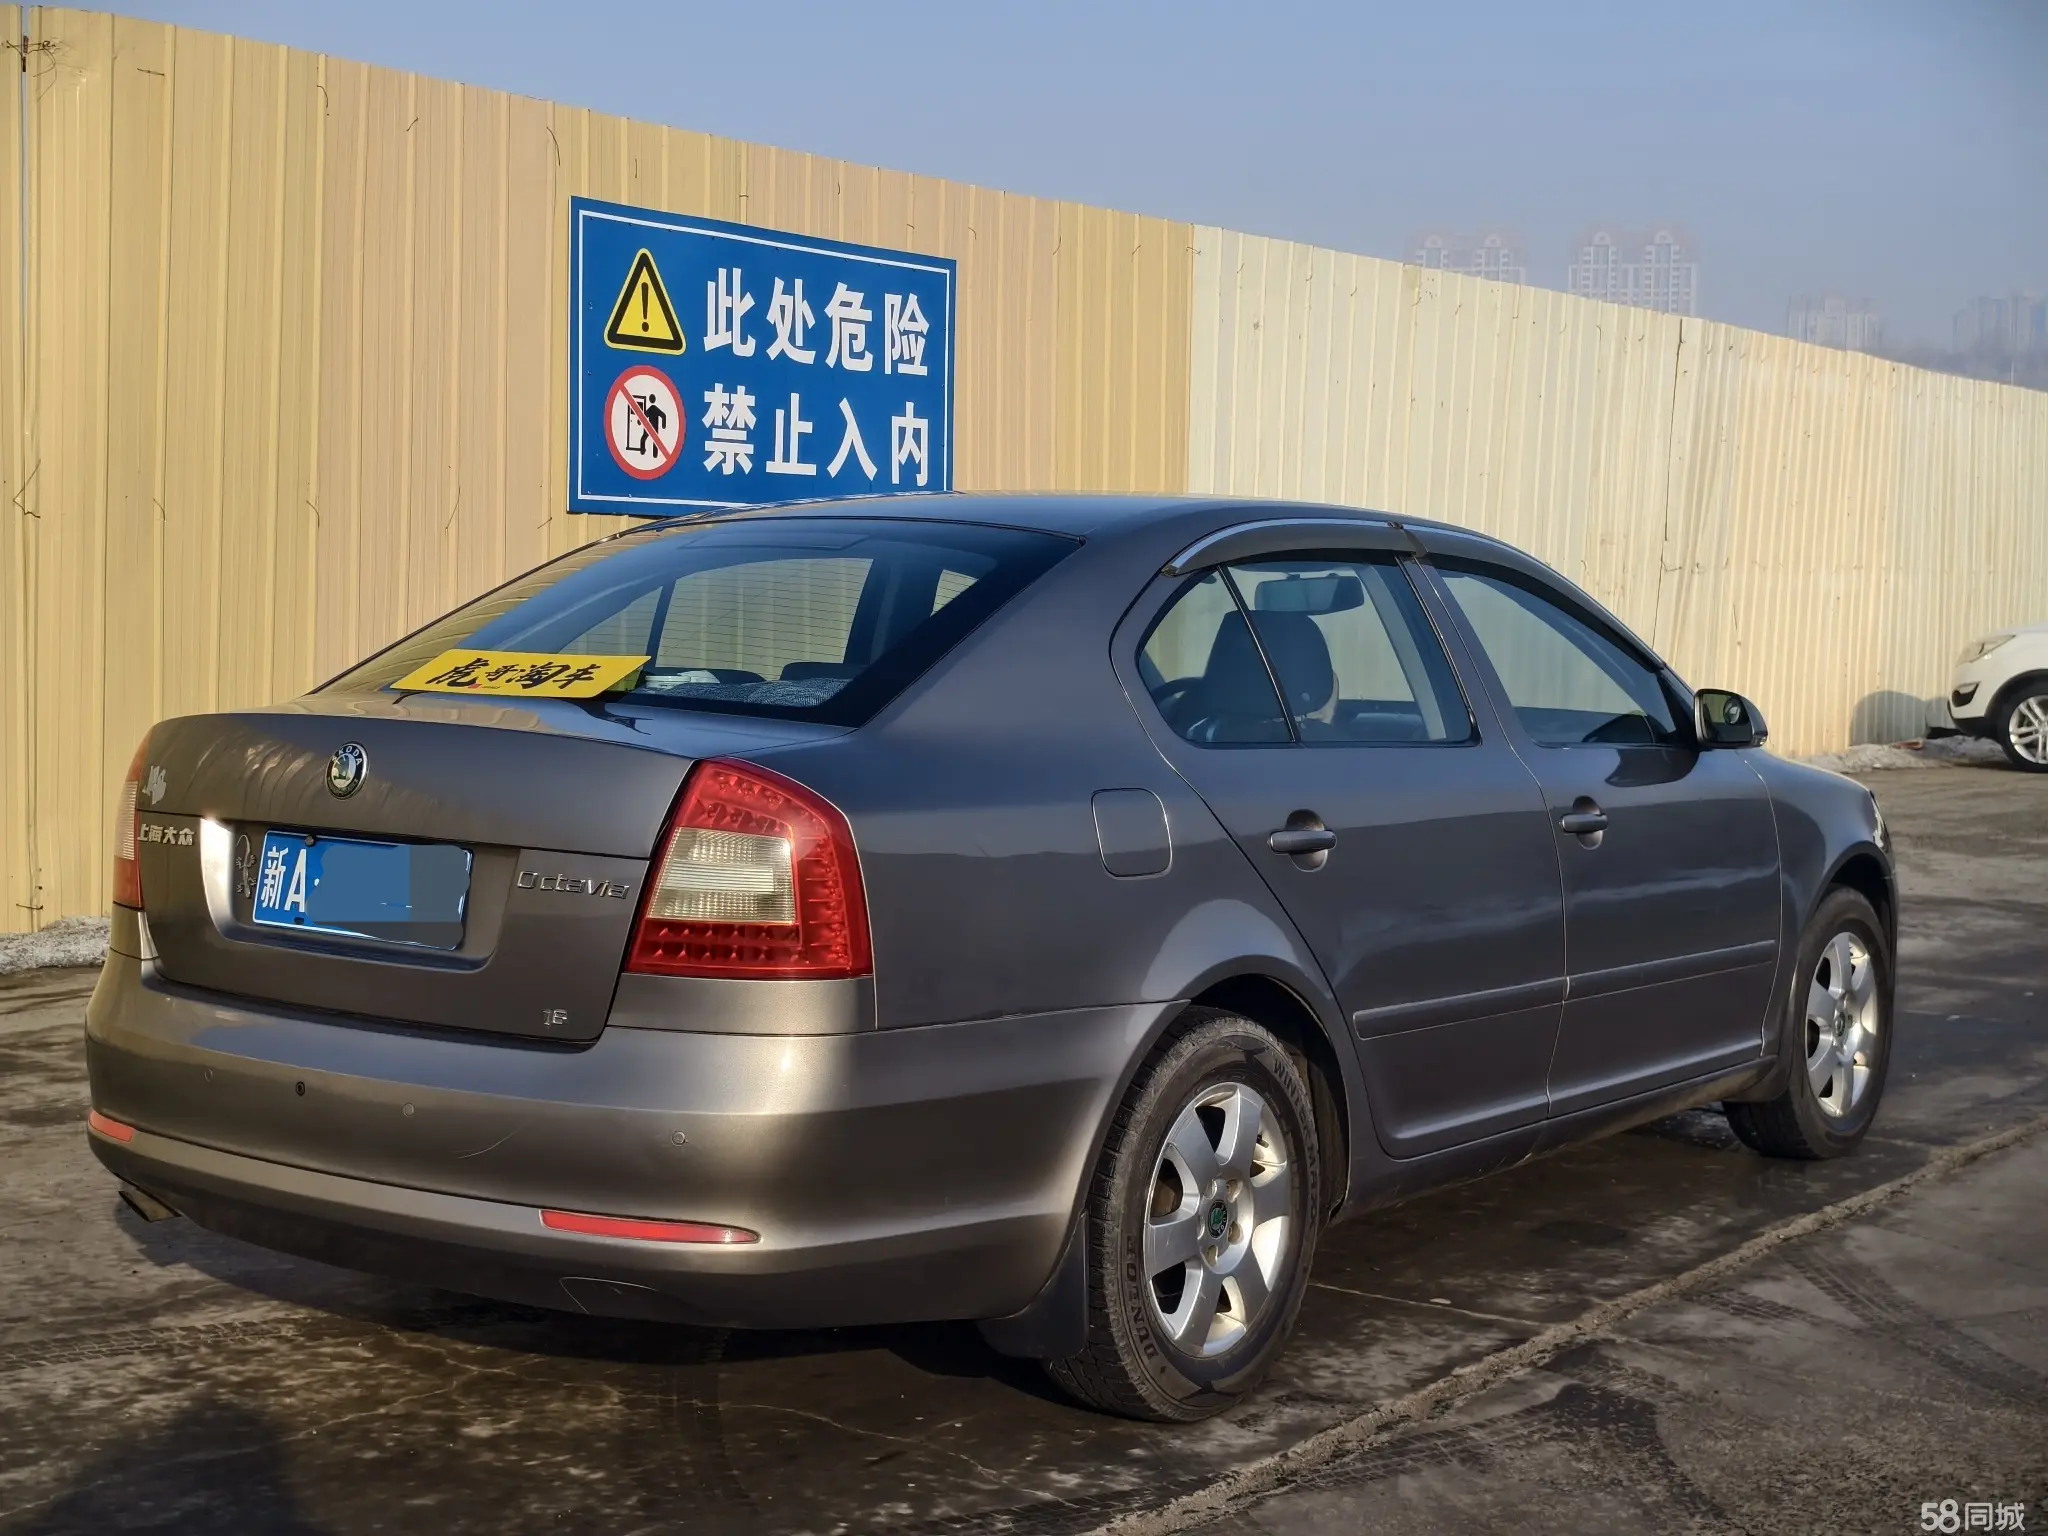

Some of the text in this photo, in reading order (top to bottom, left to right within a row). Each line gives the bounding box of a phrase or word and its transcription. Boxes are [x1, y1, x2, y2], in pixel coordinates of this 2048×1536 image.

[703, 267, 930, 376] 此处危险
[701, 382, 929, 487] 禁止入内
[137, 823, 195, 846] 上海大众
[516, 870, 630, 900] Octavia
